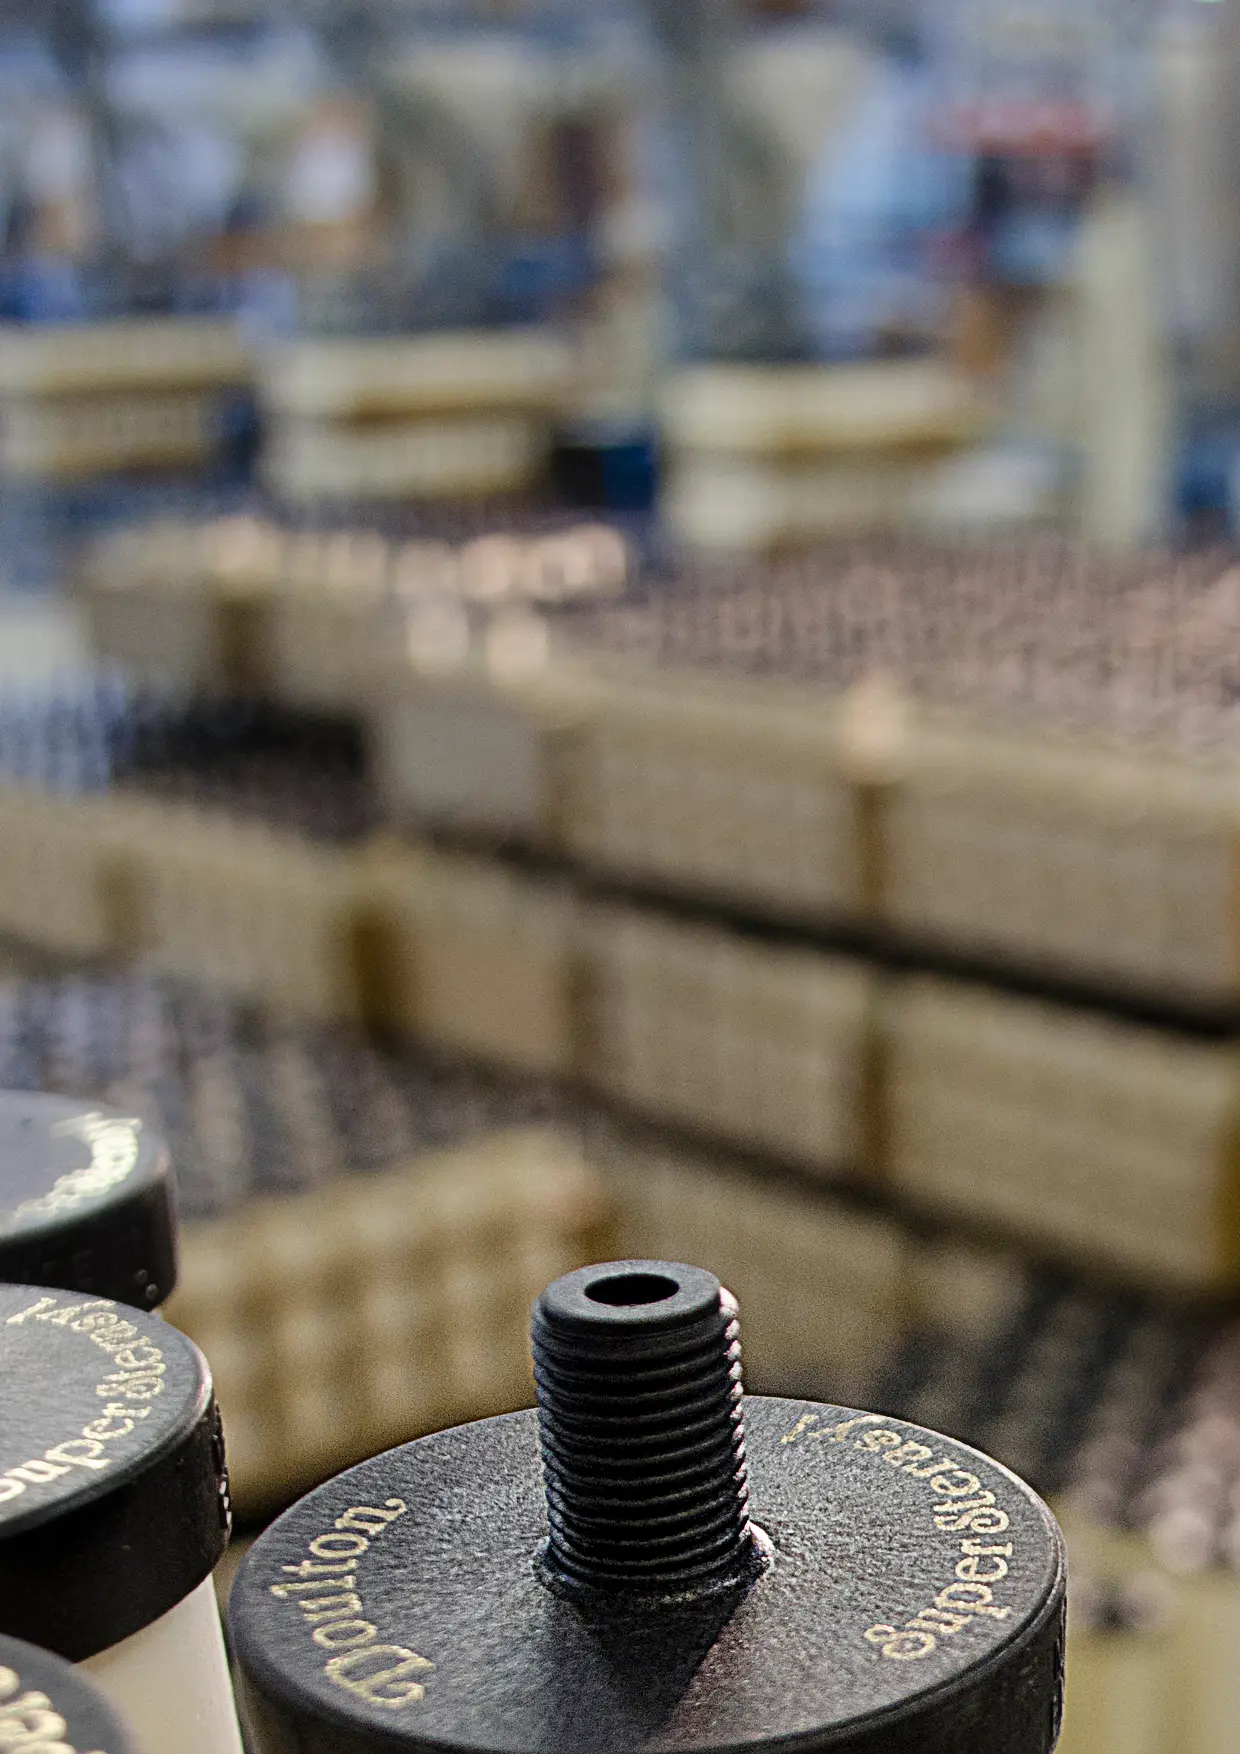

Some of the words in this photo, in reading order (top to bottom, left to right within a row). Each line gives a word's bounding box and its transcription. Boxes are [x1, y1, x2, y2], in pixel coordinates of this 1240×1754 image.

[780, 1413, 1010, 1534] Sterasyl
[269, 1498, 436, 1709] Doulton
[863, 1537, 1013, 1660] Super
